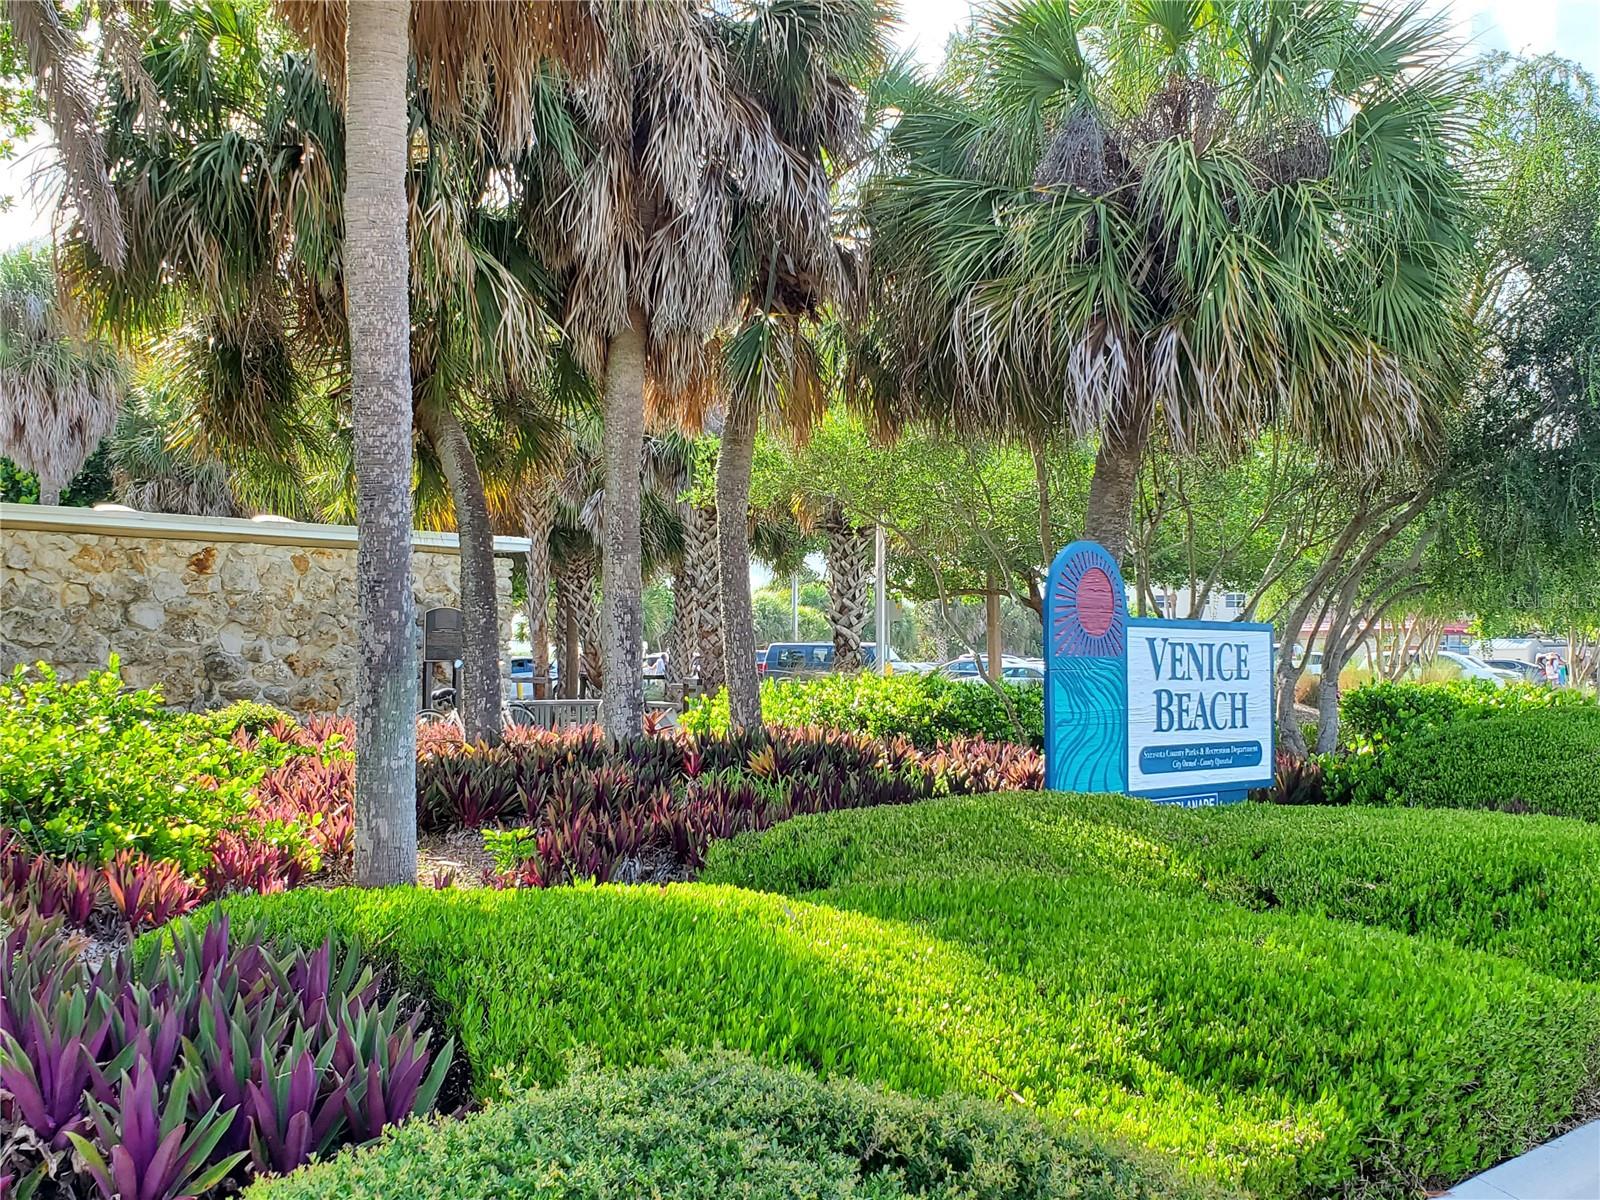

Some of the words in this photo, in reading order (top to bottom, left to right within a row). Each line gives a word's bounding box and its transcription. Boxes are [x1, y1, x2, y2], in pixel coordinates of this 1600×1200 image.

[1145, 637, 1250, 682] VENICE
[1152, 688, 1249, 733] BEACH
[1143, 750, 1166, 759] Sarasota
[1166, 749, 1185, 759] County
[1185, 747, 1199, 756] Parks
[1199, 747, 1205, 756] &
[1205, 746, 1230, 755] Recreation
[1231, 745, 1258, 755] Department
[1172, 760, 1182, 769] City
[1182, 758, 1197, 767] Owned
[1200, 758, 1214, 767] County
